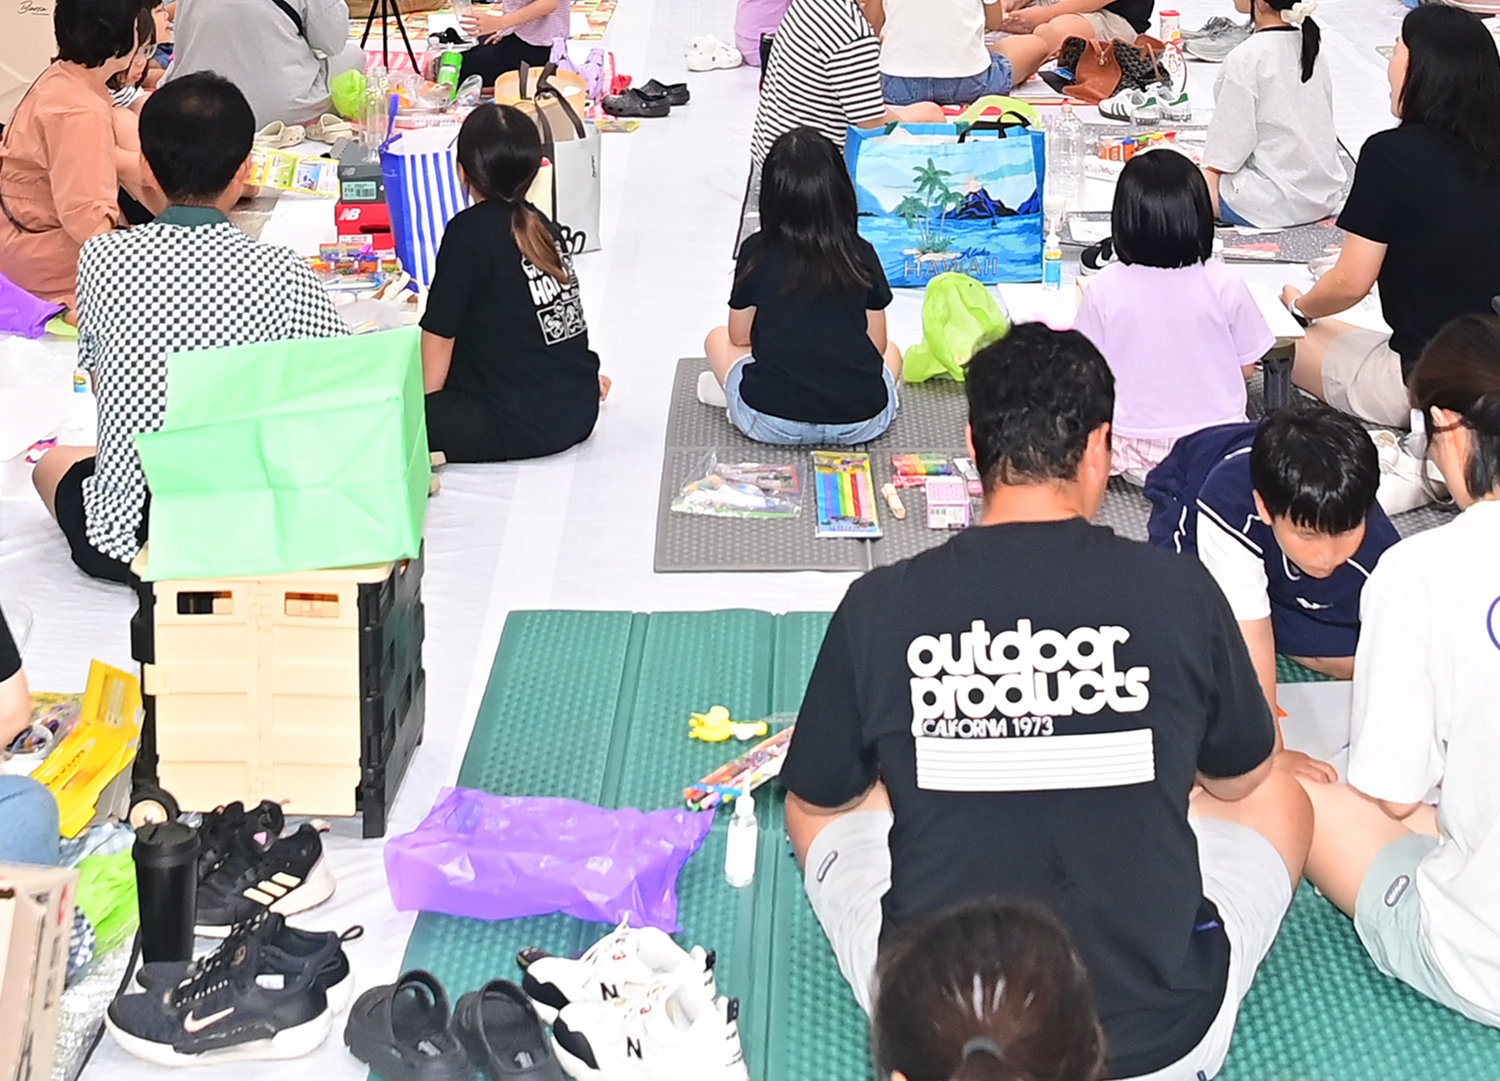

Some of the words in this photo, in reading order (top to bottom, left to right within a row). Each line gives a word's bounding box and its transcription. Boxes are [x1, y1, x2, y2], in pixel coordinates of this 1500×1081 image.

[338, 208, 362, 221] NB
[904, 257, 999, 279] HAWAII
[906, 618, 1131, 679] outdoor
[909, 666, 1151, 738] products
[1011, 715, 1055, 737] 1973
